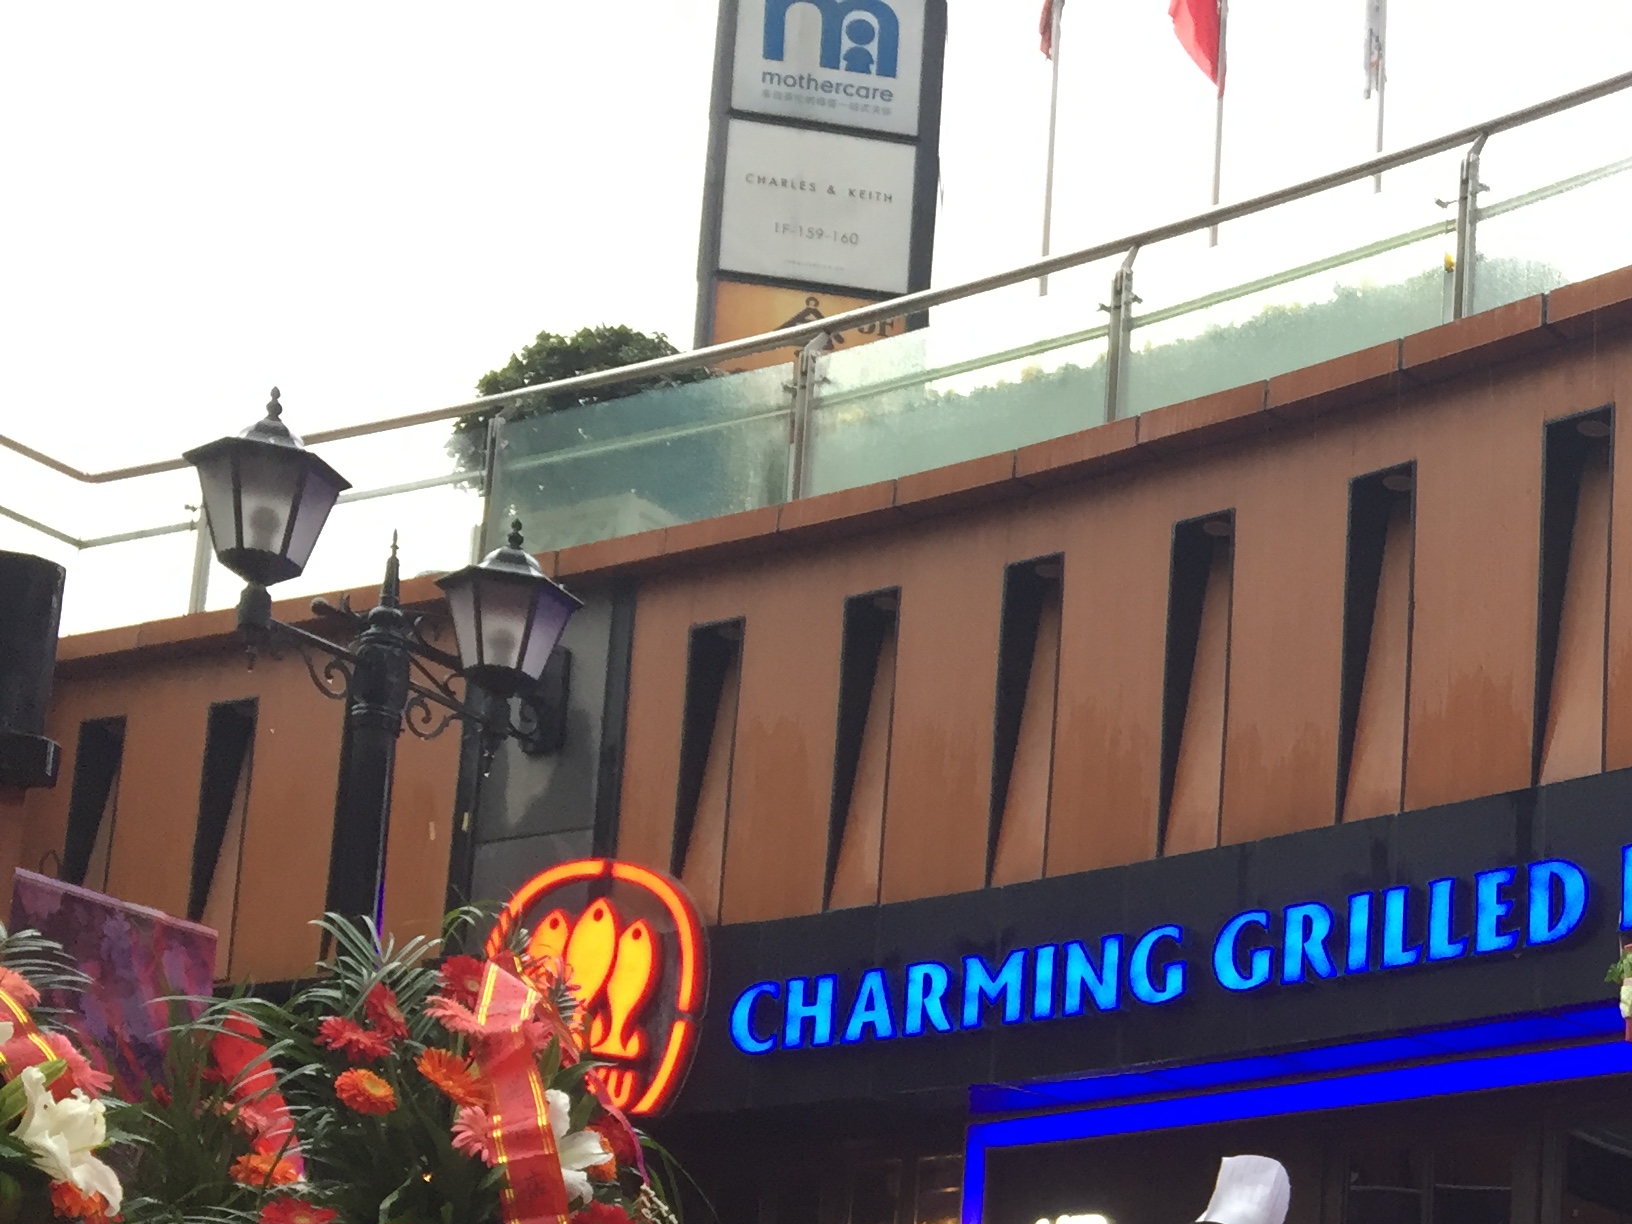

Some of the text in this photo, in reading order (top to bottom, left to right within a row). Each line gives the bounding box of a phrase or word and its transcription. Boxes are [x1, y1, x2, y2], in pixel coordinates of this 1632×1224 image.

[761, 69, 894, 103] mothercare
[745, 172, 894, 204] CHARLES & KEITH
[729, 922, 1189, 1055] CHARMING
[1212, 856, 1590, 992] GRILLED
